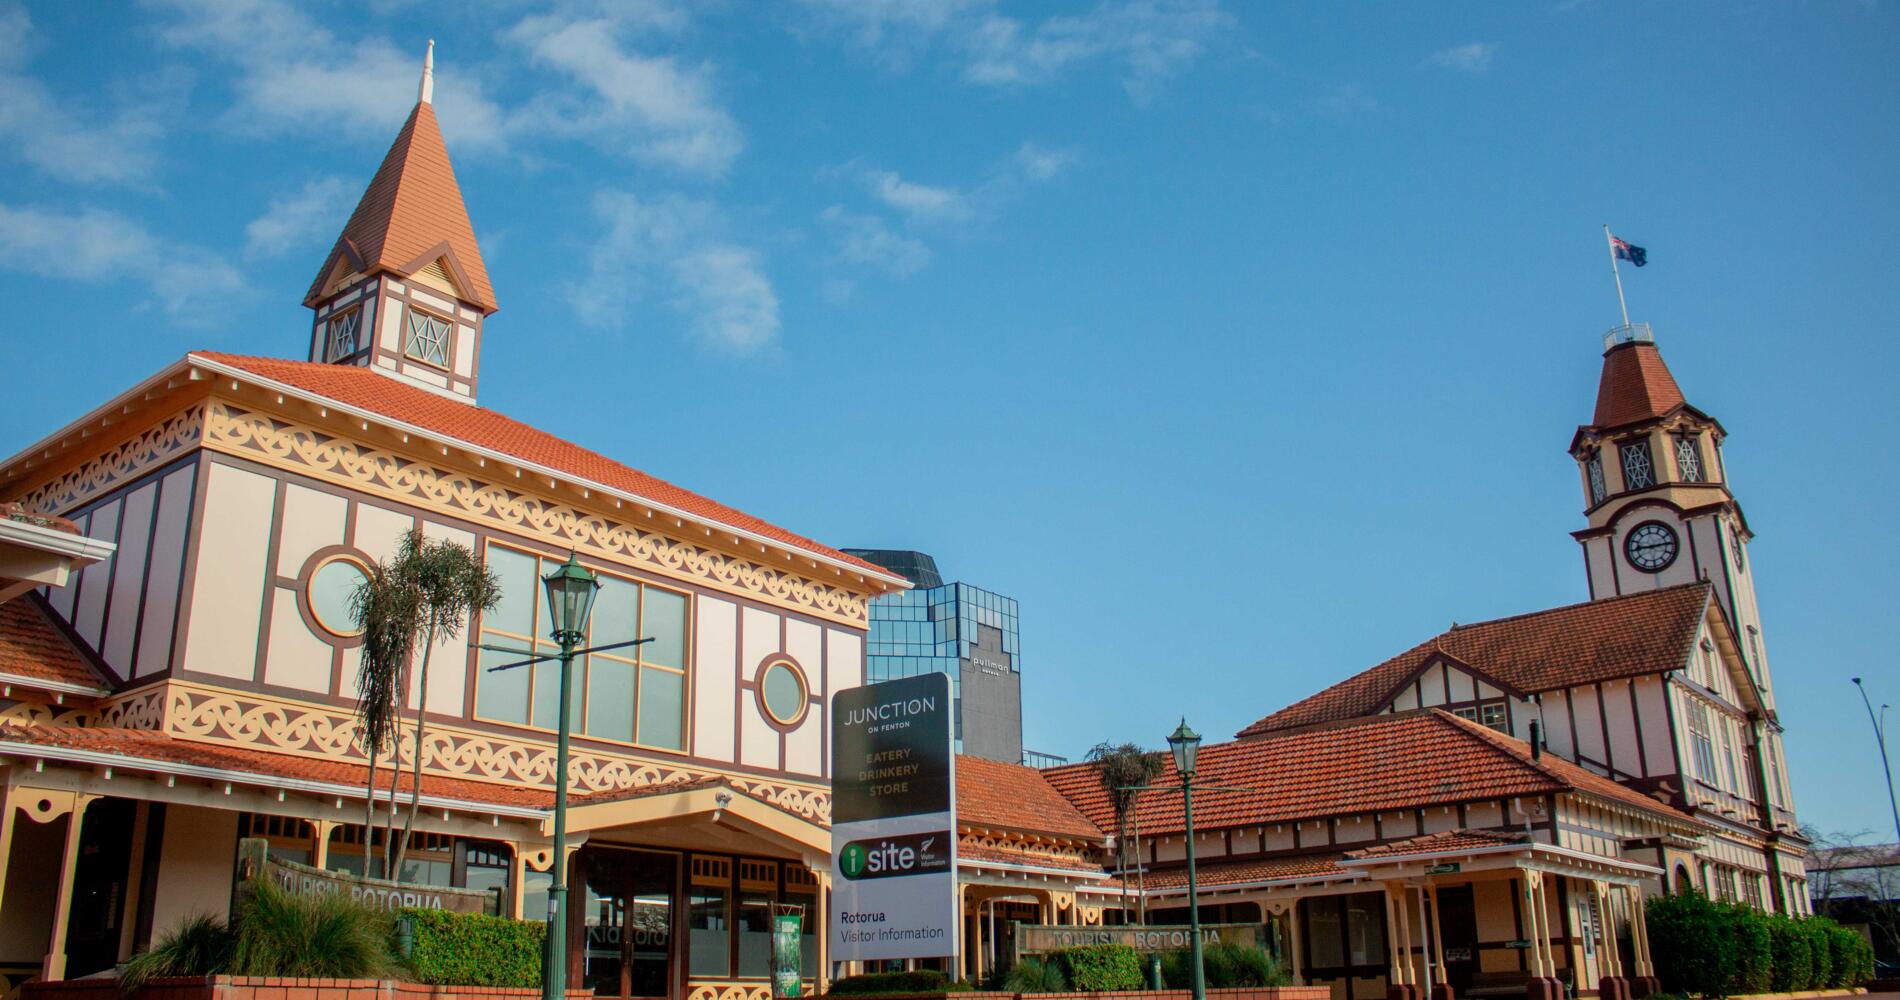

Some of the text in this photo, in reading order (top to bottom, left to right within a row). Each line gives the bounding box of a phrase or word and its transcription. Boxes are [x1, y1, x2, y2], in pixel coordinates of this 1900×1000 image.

[973, 657, 1009, 675] pullman
[844, 696, 935, 726] JUNCTION
[867, 721, 911, 734] ON FENTON
[866, 748, 912, 764] EATERY
[858, 763, 919, 782] DRINKERY
[869, 782, 909, 797] STORE
[867, 841, 915, 873] site
[841, 912, 886, 924] Rotorua
[840, 926, 944, 943] Visitor Information
